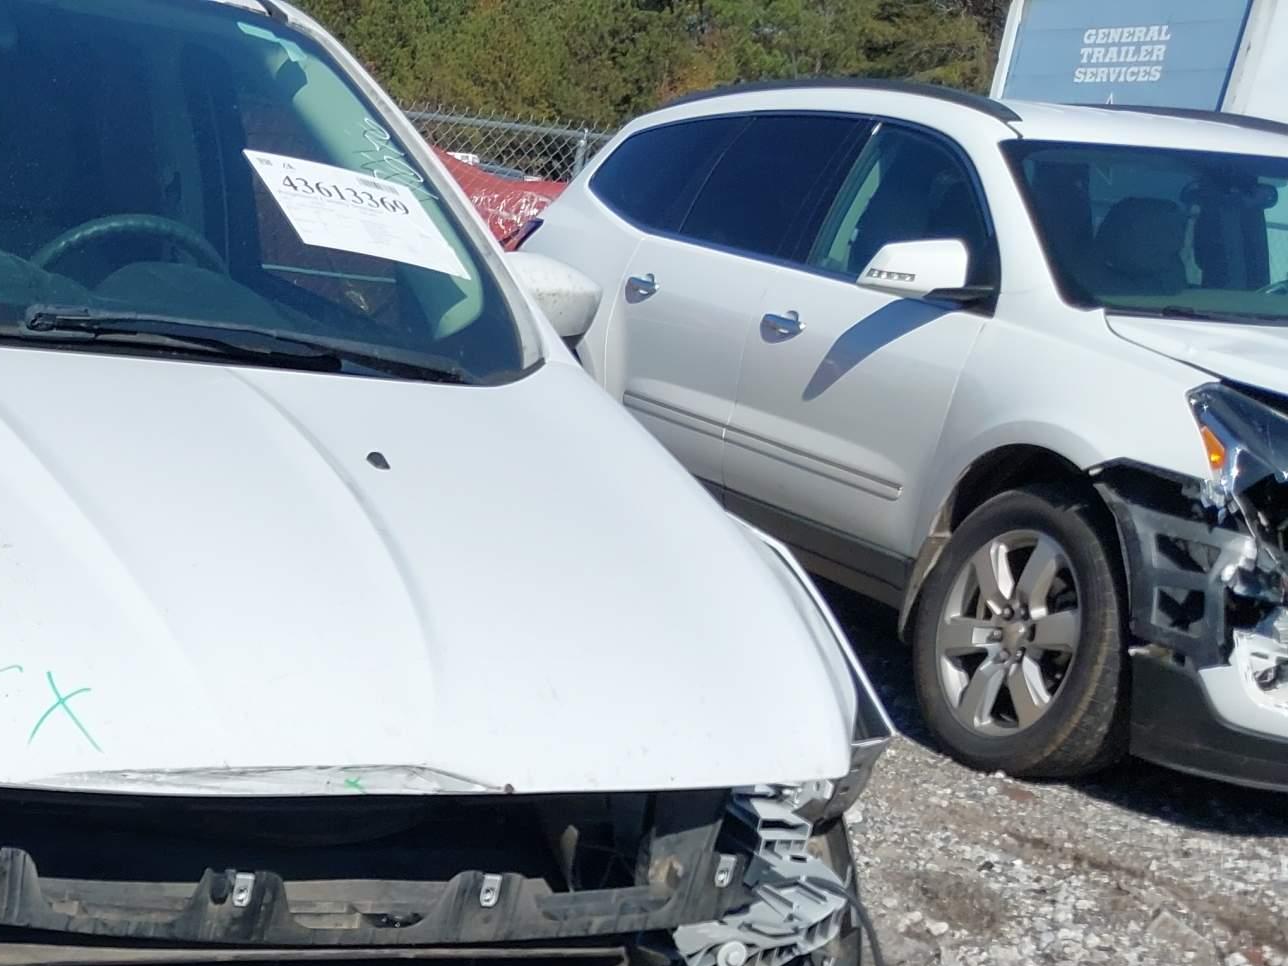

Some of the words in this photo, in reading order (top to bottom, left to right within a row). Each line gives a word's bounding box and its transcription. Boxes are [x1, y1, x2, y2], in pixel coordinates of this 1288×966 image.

[1084, 25, 1171, 44] GENERAL
[1080, 45, 1167, 63] TRAILER
[1073, 66, 1162, 83] SERVICES
[282, 175, 409, 214] 43613369
